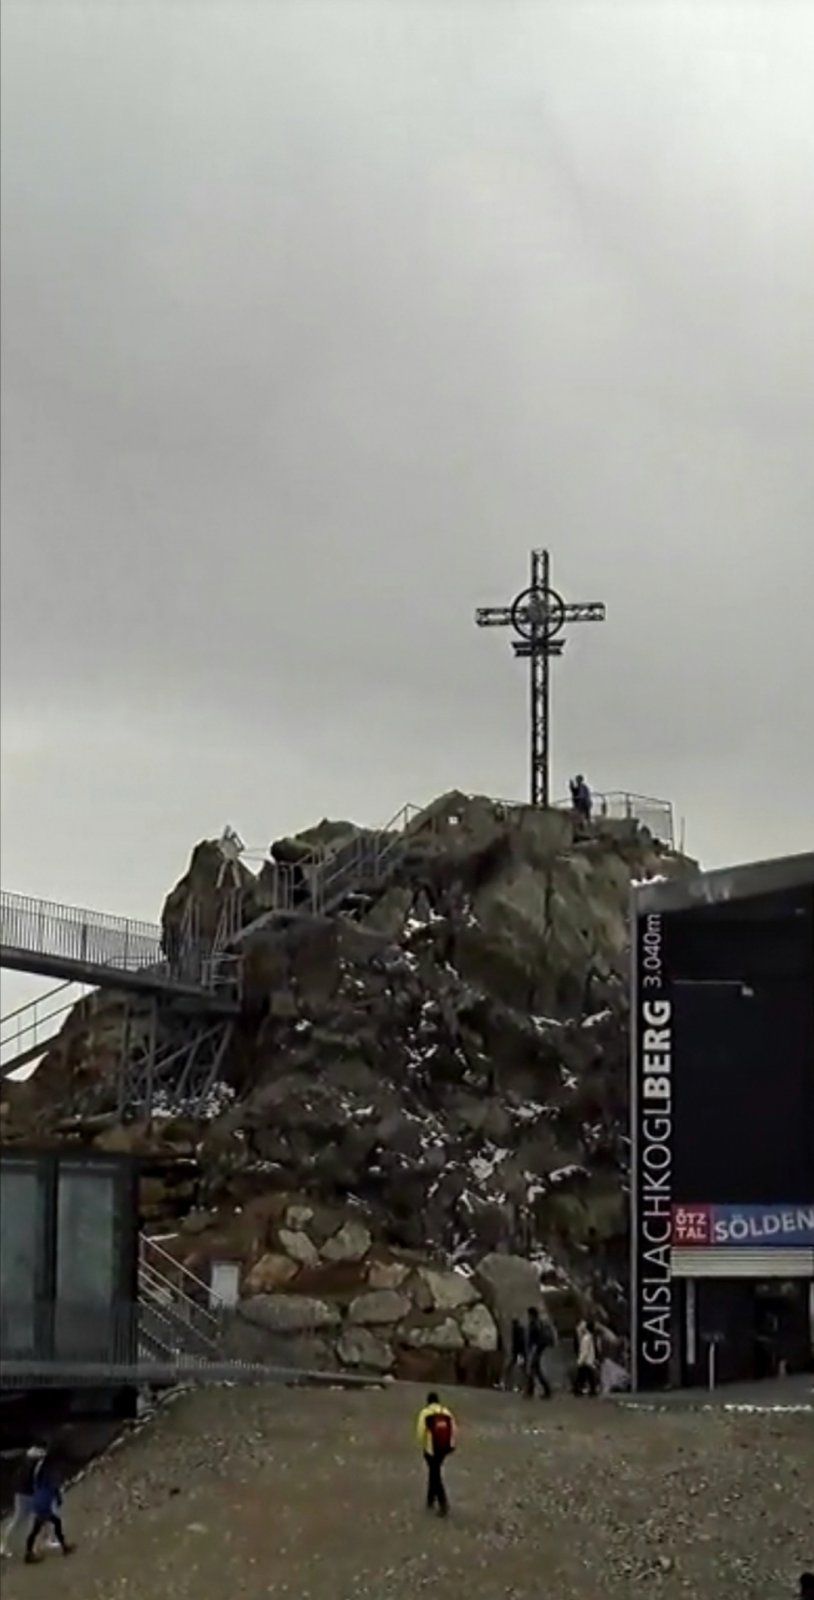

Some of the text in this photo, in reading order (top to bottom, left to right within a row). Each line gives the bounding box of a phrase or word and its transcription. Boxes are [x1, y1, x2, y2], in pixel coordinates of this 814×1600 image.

[642, 913, 672, 1364] GAISLACHKOGLBERG 3.040m
[676, 1208, 706, 1225] ÖTZ
[715, 1208, 814, 1242] SÖLDEN
[676, 1227, 706, 1240] TAL
